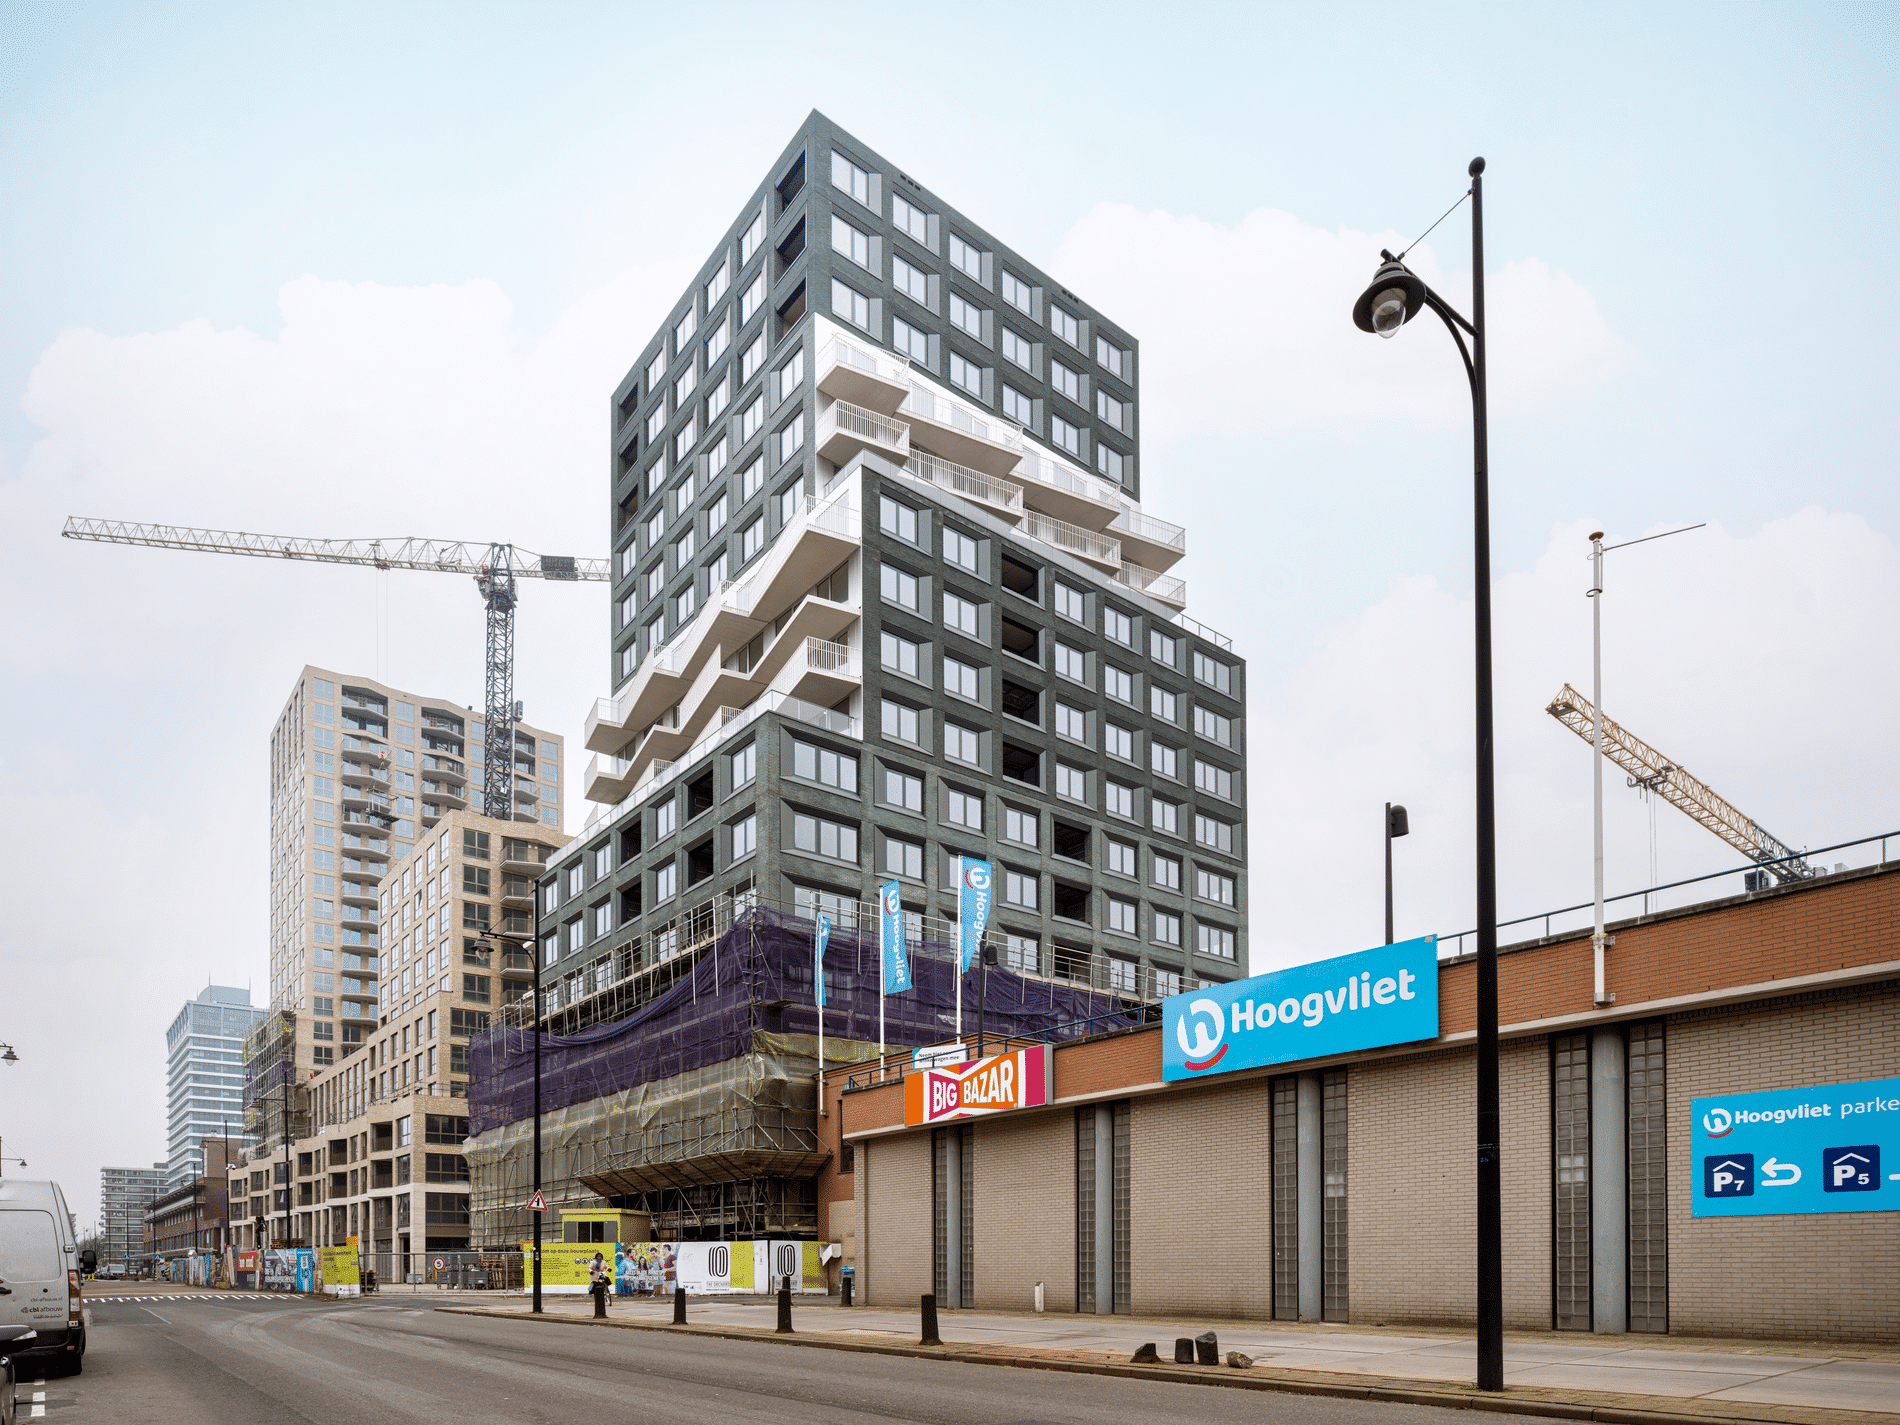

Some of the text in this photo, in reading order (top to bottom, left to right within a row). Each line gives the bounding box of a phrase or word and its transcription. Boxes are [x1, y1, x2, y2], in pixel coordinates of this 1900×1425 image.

[892, 915, 905, 984] Hoogvliet
[1231, 968, 1416, 1034] Hoogvliet
[933, 1059, 1014, 1113] BIG BAZAR
[1735, 1103, 1831, 1124] Hoogvliet
[1841, 1096, 1900, 1120] parke
